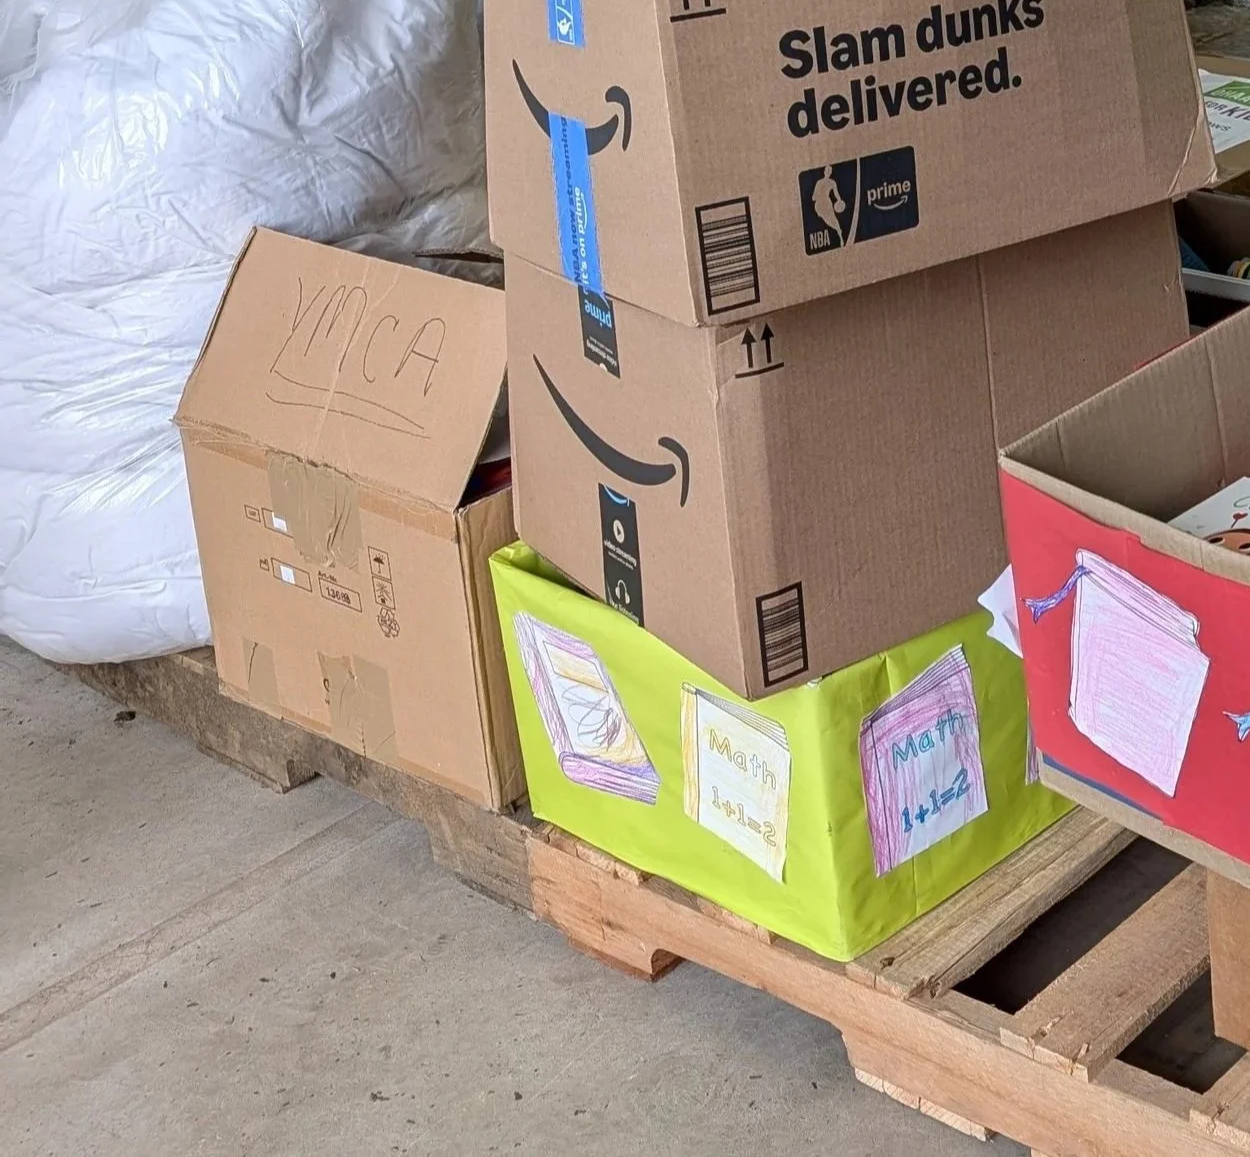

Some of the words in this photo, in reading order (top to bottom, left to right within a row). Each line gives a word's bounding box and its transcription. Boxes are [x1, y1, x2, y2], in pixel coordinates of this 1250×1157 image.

[778, 19, 906, 80] Slam
[786, 45, 1023, 139] delivered.
[558, 116, 577, 210] streaming
[866, 176, 912, 204] prime
[573, 186, 588, 234] prime
[809, 227, 831, 251] NBA
[270, 276, 447, 398] YMCA
[584, 298, 614, 331] prime
[708, 727, 778, 790] Math
[891, 710, 965, 764] Math
[711, 785, 777, 847] 1+1=2
[900, 768, 972, 833] 1+1=2
